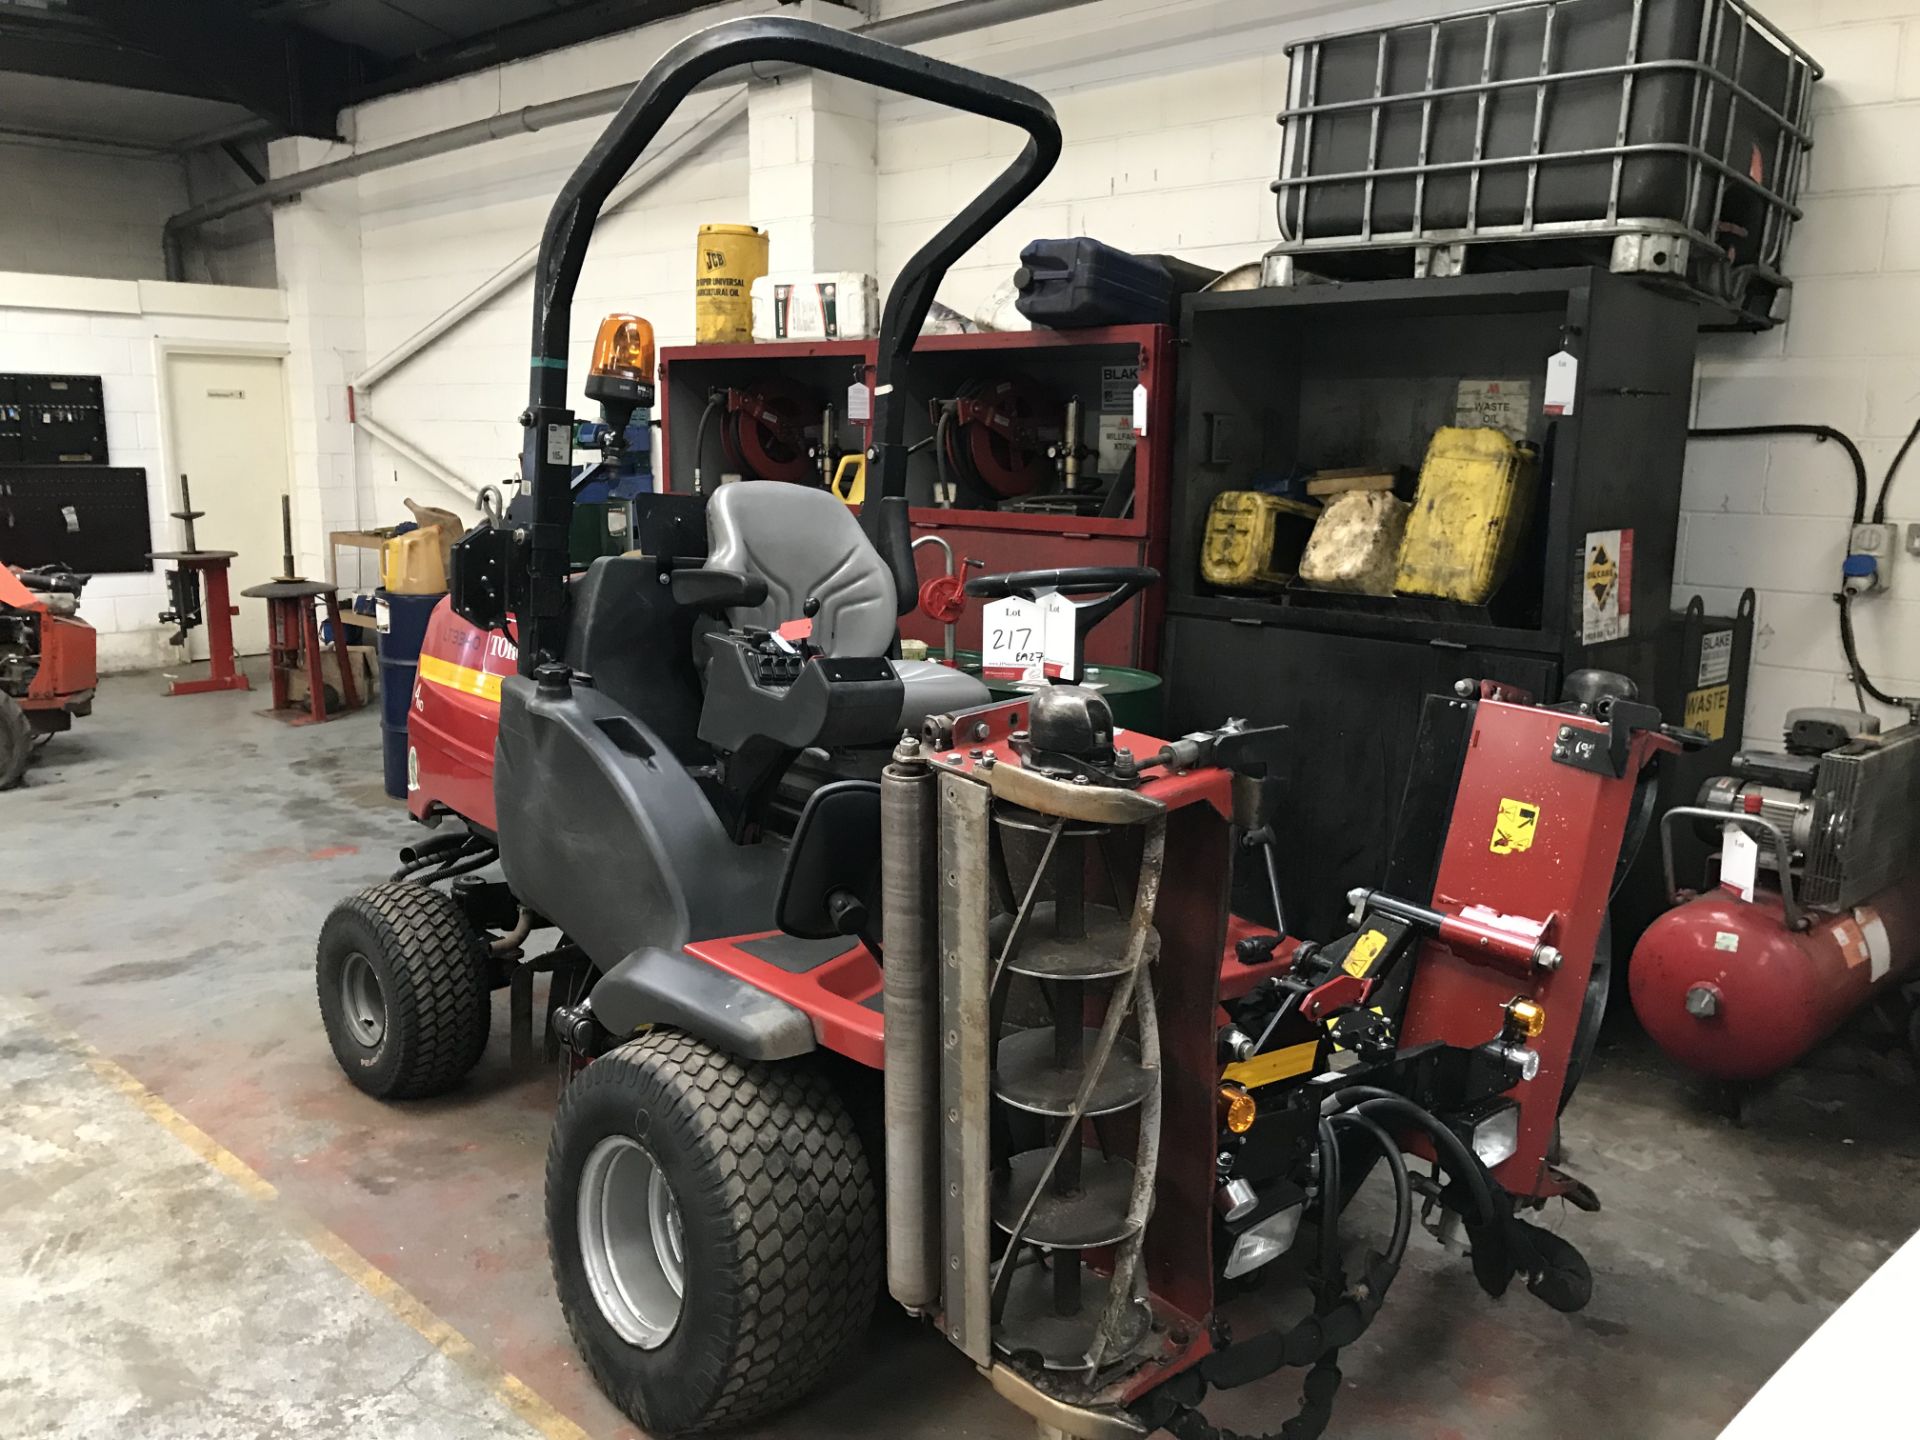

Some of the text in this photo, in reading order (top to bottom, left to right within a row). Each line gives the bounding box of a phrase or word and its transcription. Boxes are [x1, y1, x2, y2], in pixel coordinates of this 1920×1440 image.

[706, 252, 724, 270] JCB
[712, 278, 744, 287] UNIVERSAL
[729, 288, 740, 297] OIL
[1104, 368, 1138, 380] BLAK
[1474, 402, 1510, 412] WASTE
[1483, 414, 1500, 424] OIL
[1005, 607, 1021, 617] Lot
[1049, 603, 1060, 613] Lot
[992, 628, 1032, 650] 217
[1702, 633, 1731, 650] BLAKE
[1687, 690, 1728, 715] WASTE
